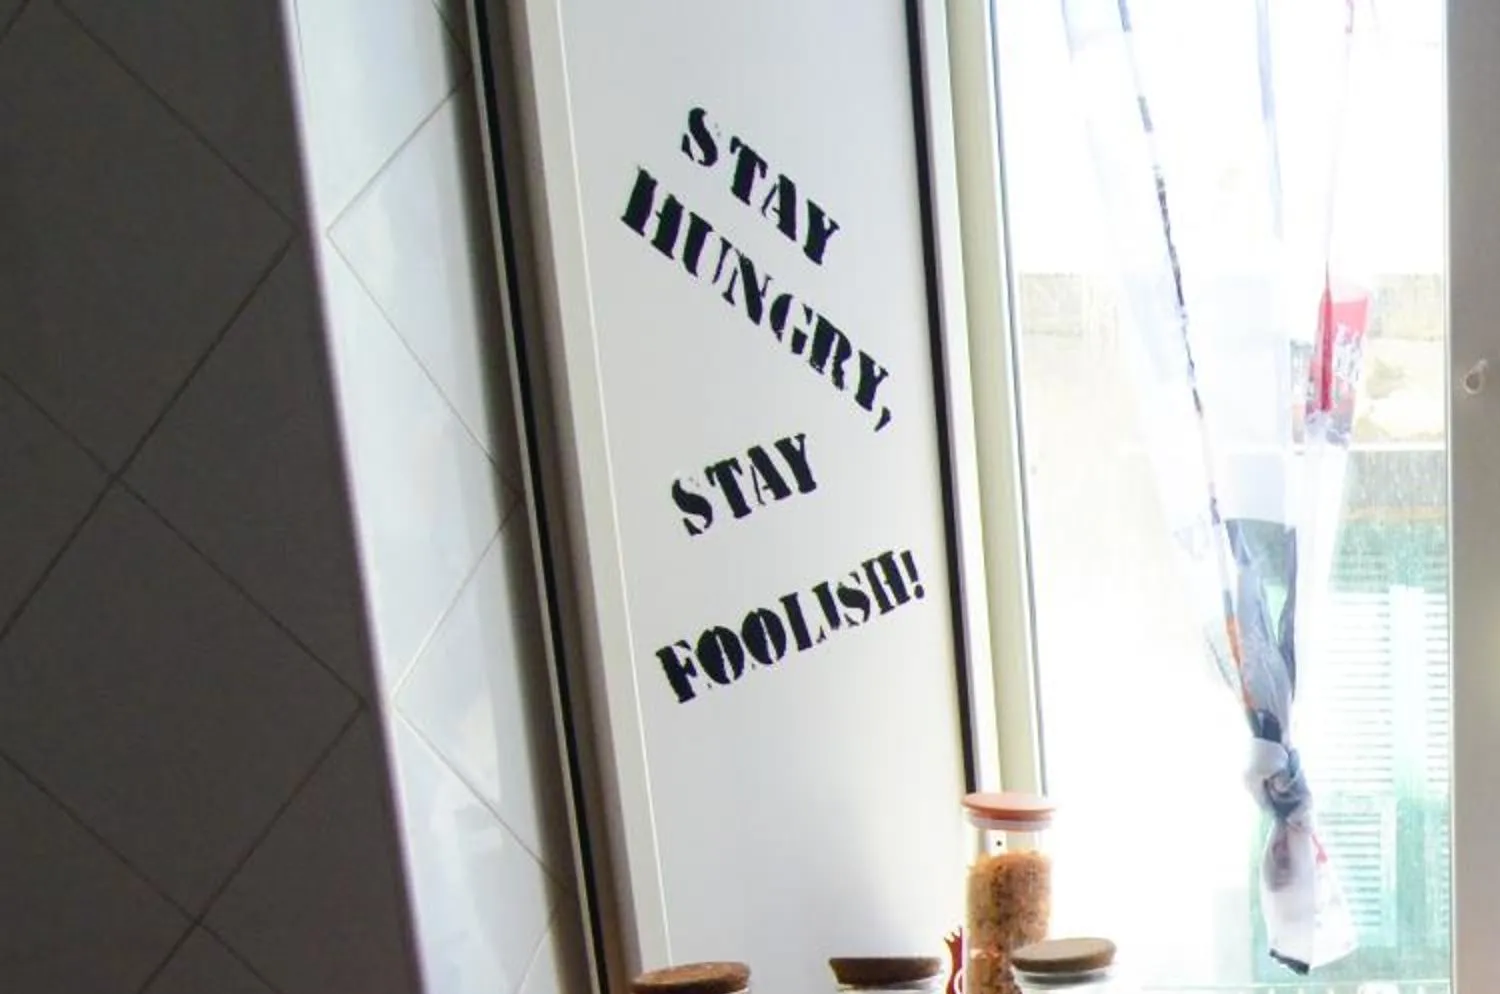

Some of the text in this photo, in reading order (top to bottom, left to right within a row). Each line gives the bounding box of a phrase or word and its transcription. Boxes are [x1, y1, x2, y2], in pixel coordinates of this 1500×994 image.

[680, 106, 840, 266] STAY
[620, 165, 892, 432] HUNGRY,
[671, 432, 818, 537] STAY
[655, 549, 926, 704] FOOLISH!
